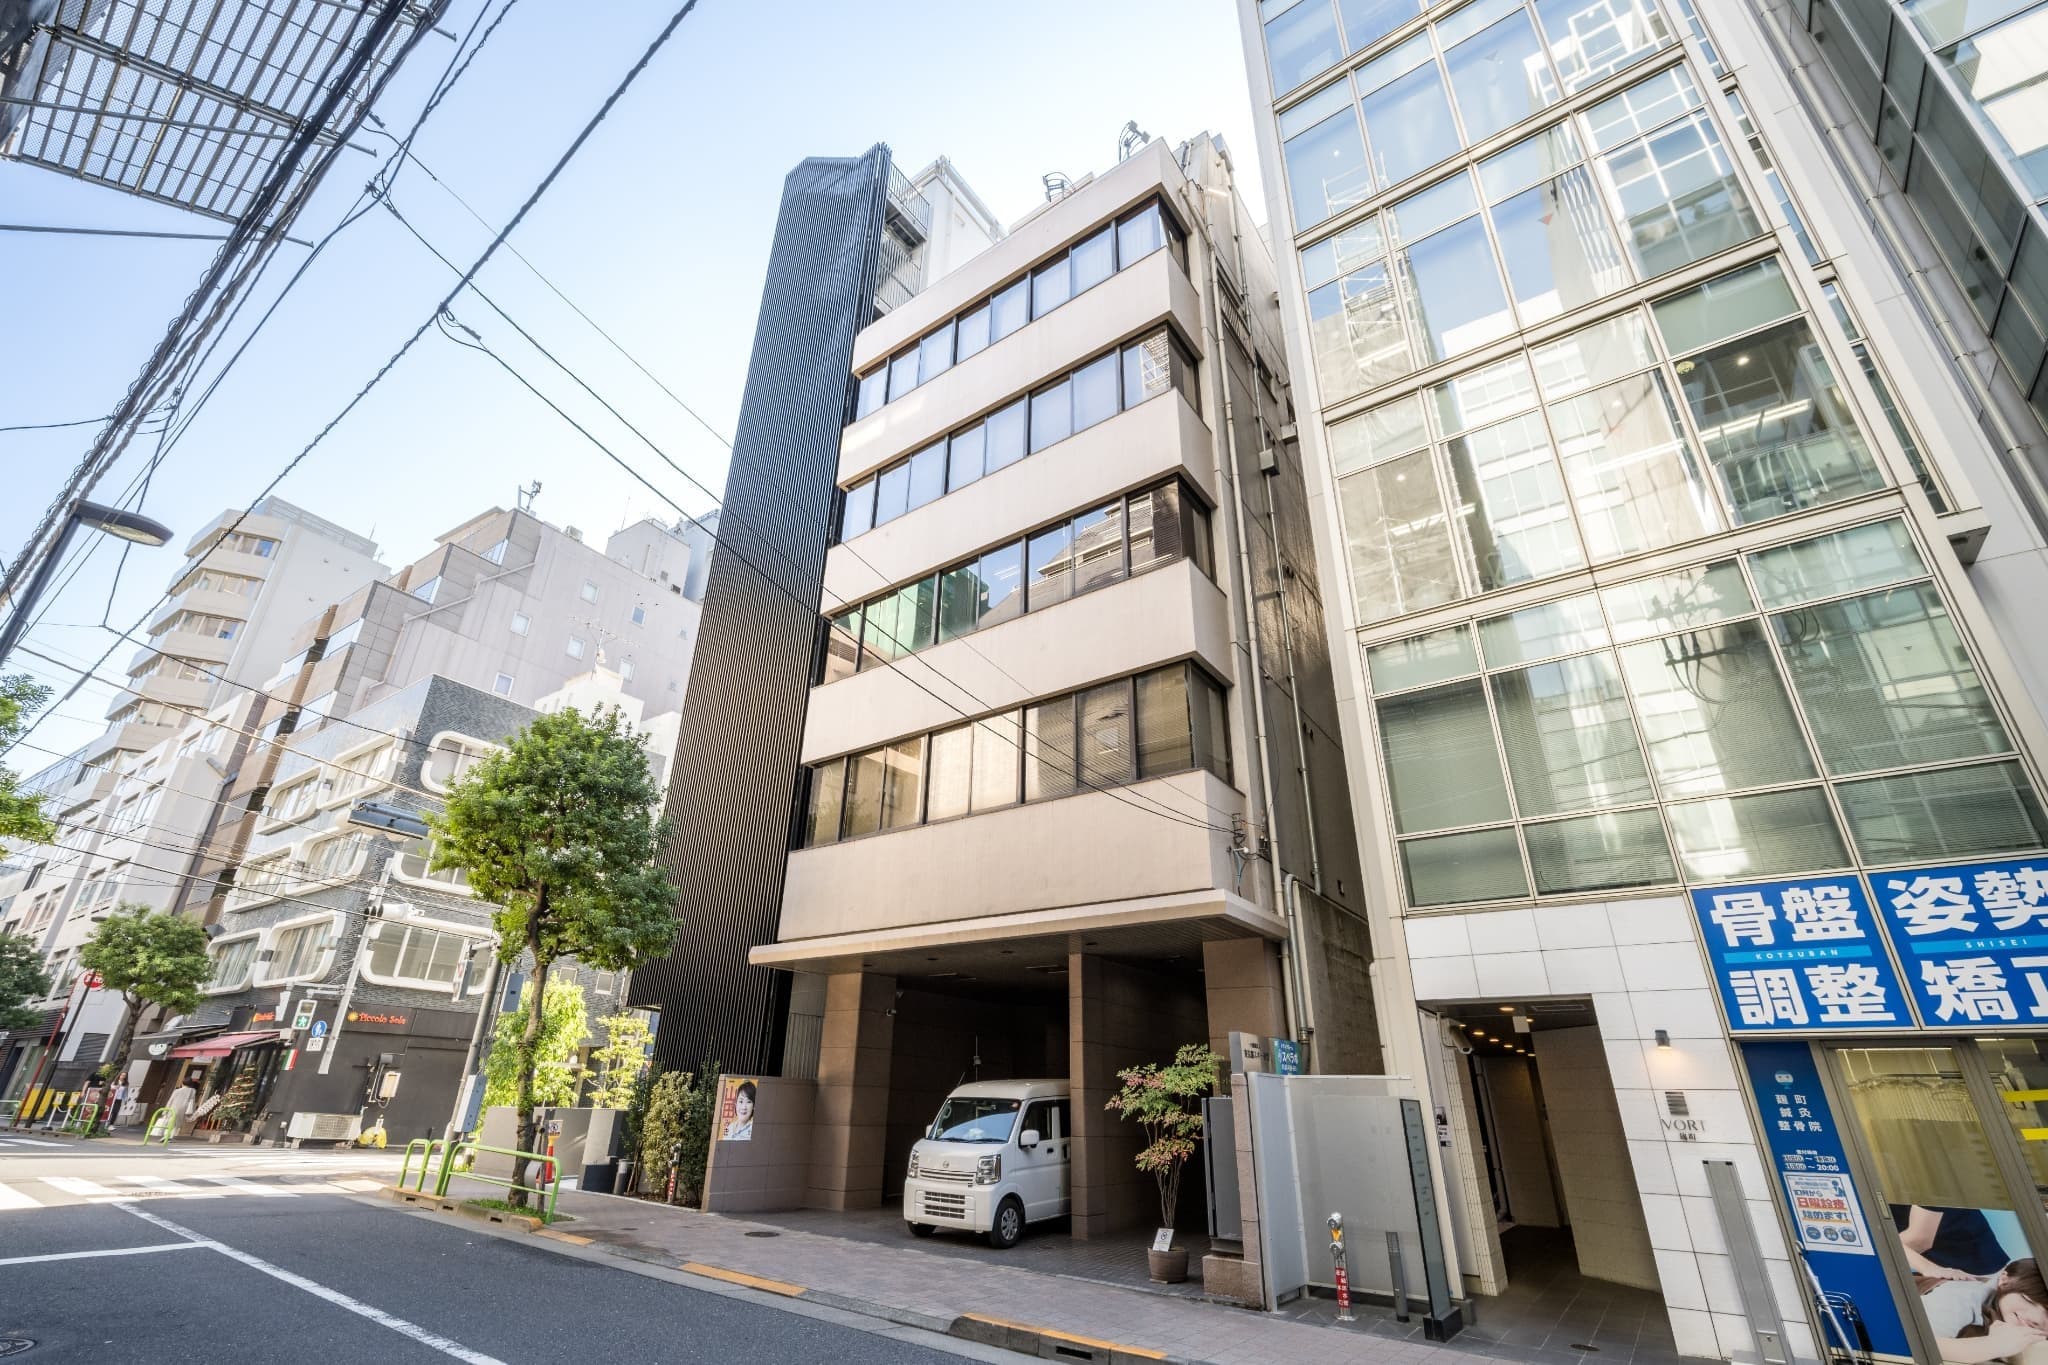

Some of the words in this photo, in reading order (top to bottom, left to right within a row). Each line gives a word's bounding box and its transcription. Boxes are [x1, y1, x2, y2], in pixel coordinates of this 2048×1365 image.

[1886, 866, 2048, 937] 姿勢
[1710, 885, 1867, 948] 骨盤
[1965, 939, 2029, 950] SHISEI
[1754, 949, 1840, 961] KOTSUBAN
[1729, 963, 1897, 1025] 調整
[1777, 1120, 1823, 1132] 整骨院
[1796, 1196, 1846, 1209] 日曜診療
